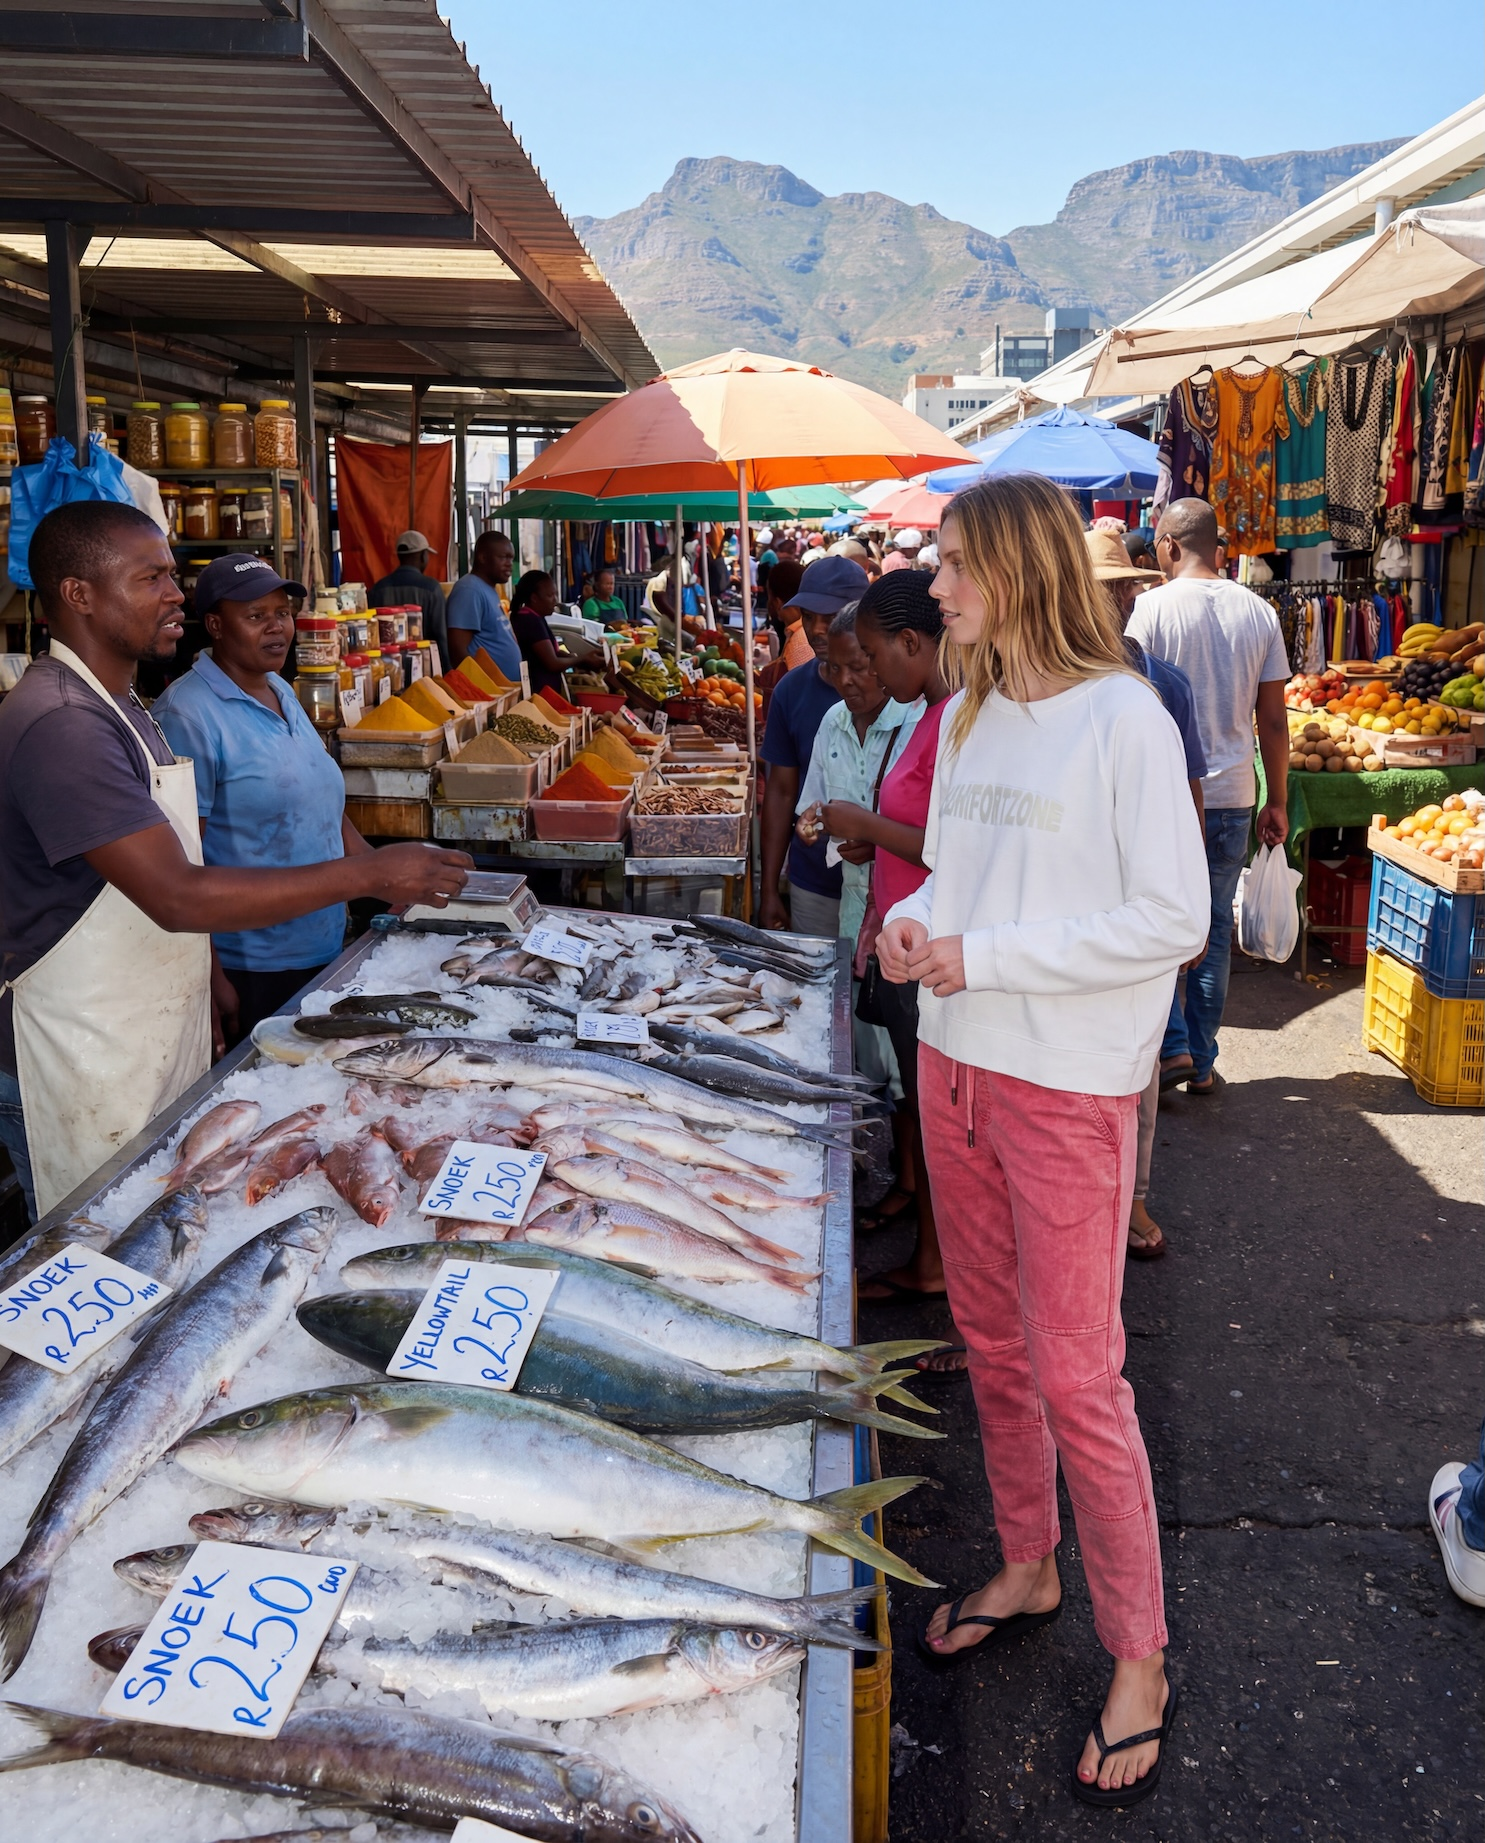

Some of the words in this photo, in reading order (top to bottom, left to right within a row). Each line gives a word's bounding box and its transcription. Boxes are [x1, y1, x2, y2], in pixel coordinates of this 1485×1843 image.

[427, 1156, 476, 1211] SNOEK
[0, 1257, 88, 1323] SNOEK
[399, 1267, 471, 1370] YELLOWTAIL
[123, 1570, 230, 1706] SNOEK
